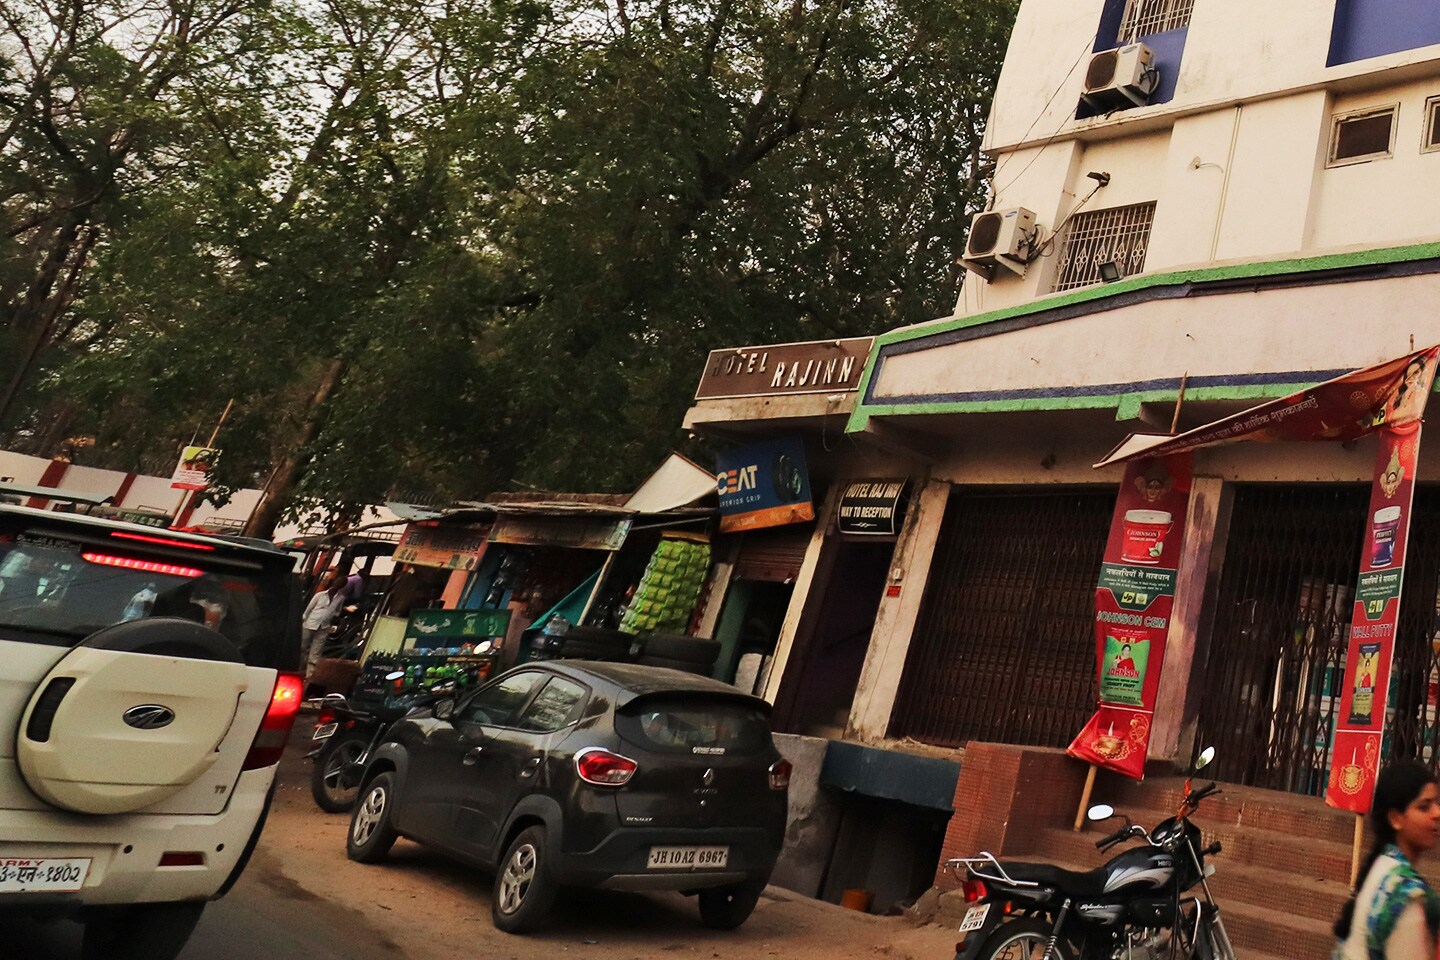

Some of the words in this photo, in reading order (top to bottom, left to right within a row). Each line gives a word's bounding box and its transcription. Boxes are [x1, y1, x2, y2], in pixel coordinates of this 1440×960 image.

[717, 465, 758, 496] CEAT
[845, 483, 871, 498] HOTEL
[841, 506, 854, 517] WAY
[853, 506, 861, 517] TO
[861, 506, 892, 518] RECEPTION
[1096, 610, 1142, 626] JOHNSON
[653, 850, 670, 863] JH
[669, 850, 681, 863] 10
[681, 850, 695, 863] AZ
[699, 850, 724, 863] 6967
